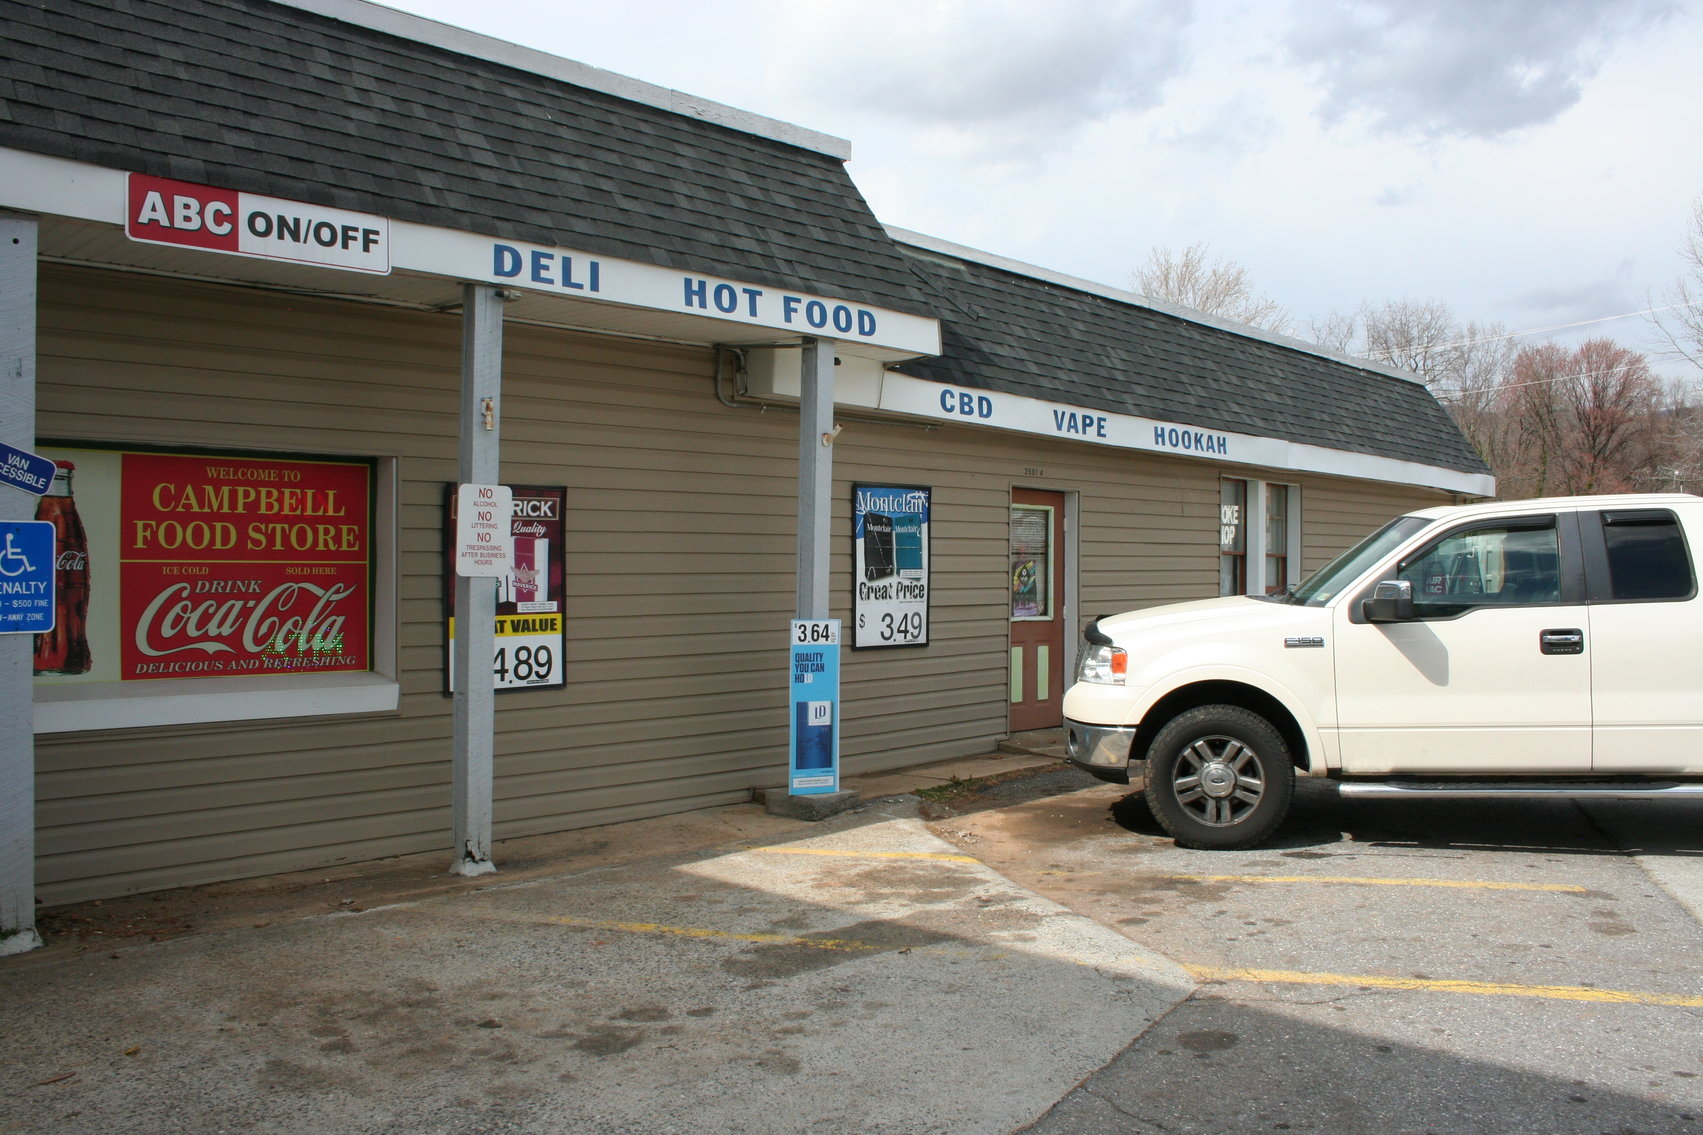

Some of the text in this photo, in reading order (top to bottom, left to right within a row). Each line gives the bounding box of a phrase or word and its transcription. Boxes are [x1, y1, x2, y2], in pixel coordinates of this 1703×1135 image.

[137, 190, 380, 253] ABC ON/OFF
[493, 244, 600, 293] DELI
[683, 277, 877, 337] HOT FOOD
[940, 388, 993, 420] CBD
[1053, 409, 1107, 438] VAPE
[1153, 425, 1228, 455] HOOKAH
[7, 453, 30, 471] VAN
[206, 466, 301, 482] WELCOME TO
[152, 482, 346, 516] CAMPBELL
[478, 488, 493, 499] NO
[856, 491, 924, 513] Montclair
[477, 511, 492, 521] NO
[511, 500, 554, 517] RICK
[1221, 505, 1239, 525] OKE
[133, 520, 359, 551] FOOD STORE
[477, 532, 492, 543] NO
[512, 521, 547, 537] Quality
[56, 551, 87, 571] Cola
[162, 566, 209, 575] ICE COLD
[286, 566, 337, 575] SOLD HERE
[195, 580, 263, 593] DRINK
[859, 581, 925, 601] Great Price
[26, 613, 44, 621] ZONE
[135, 582, 358, 657] Coca-Cola
[510, 618, 558, 633] VALUE
[880, 611, 923, 642] 3.49
[135, 655, 356, 675] DELICIOUS AND REFRESHING
[794, 652, 824, 663] QUALITY
[795, 662, 825, 673] YOU CAN
